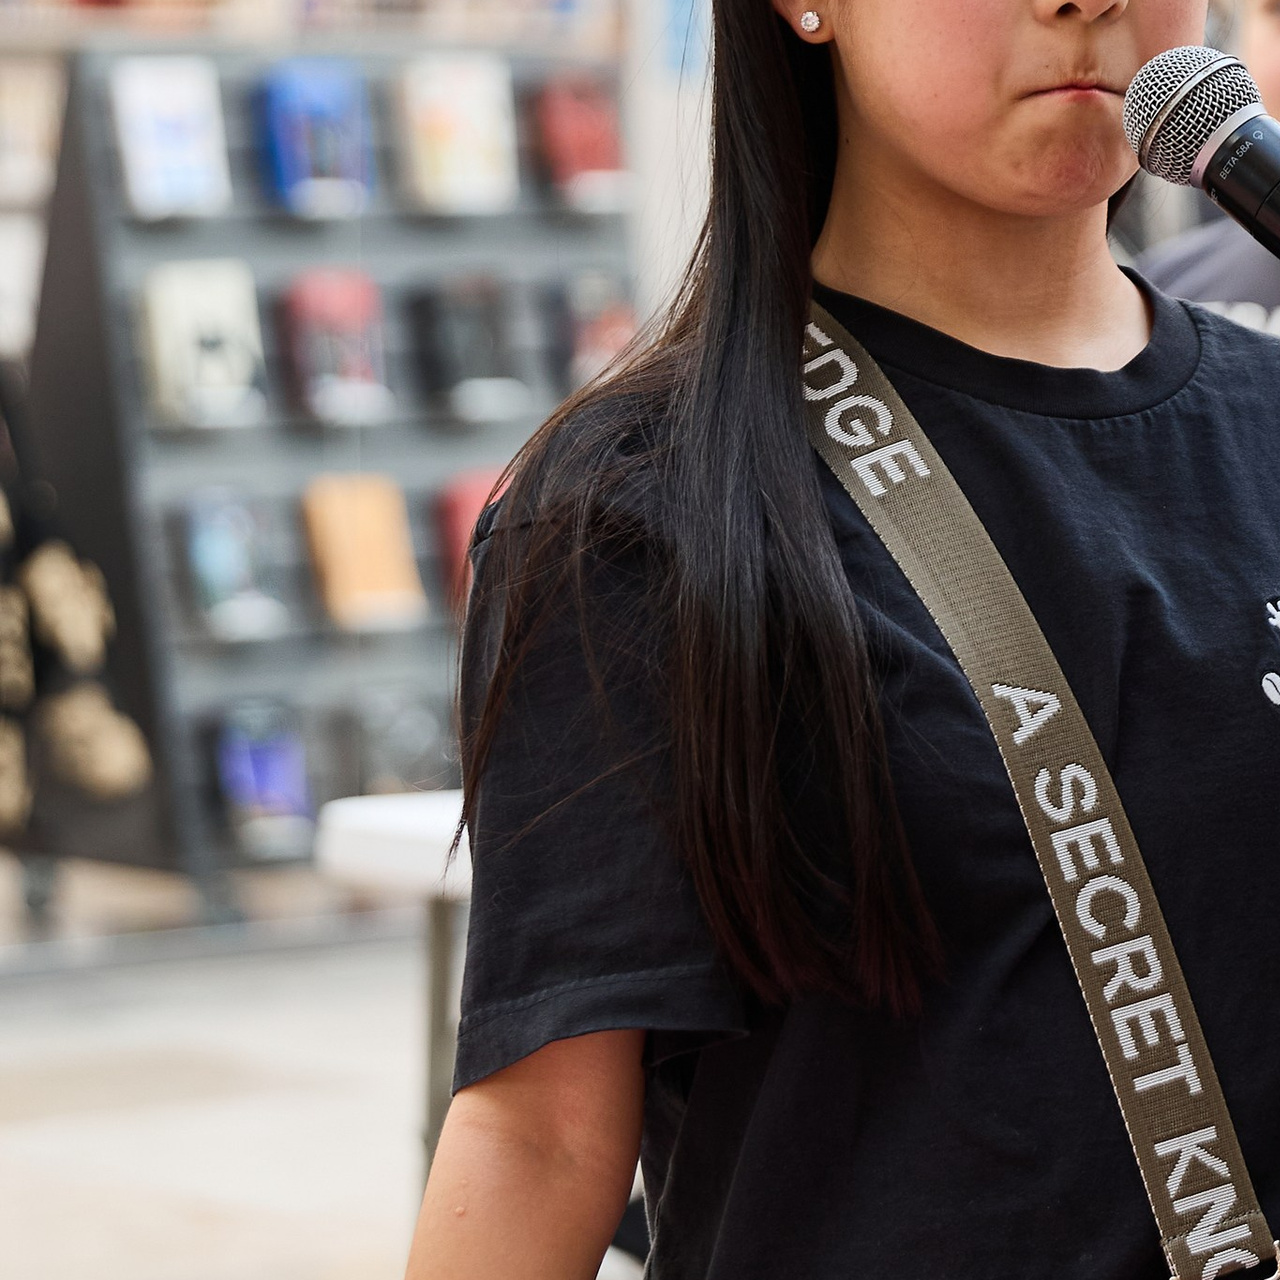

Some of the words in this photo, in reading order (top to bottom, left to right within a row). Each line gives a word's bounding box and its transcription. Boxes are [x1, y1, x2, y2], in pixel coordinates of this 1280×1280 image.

[1220, 156, 1239, 180] BETA
[1235, 140, 1254, 158] 58A
[991, 683, 1062, 746] A
[1034, 762, 1204, 1096] SECRET
